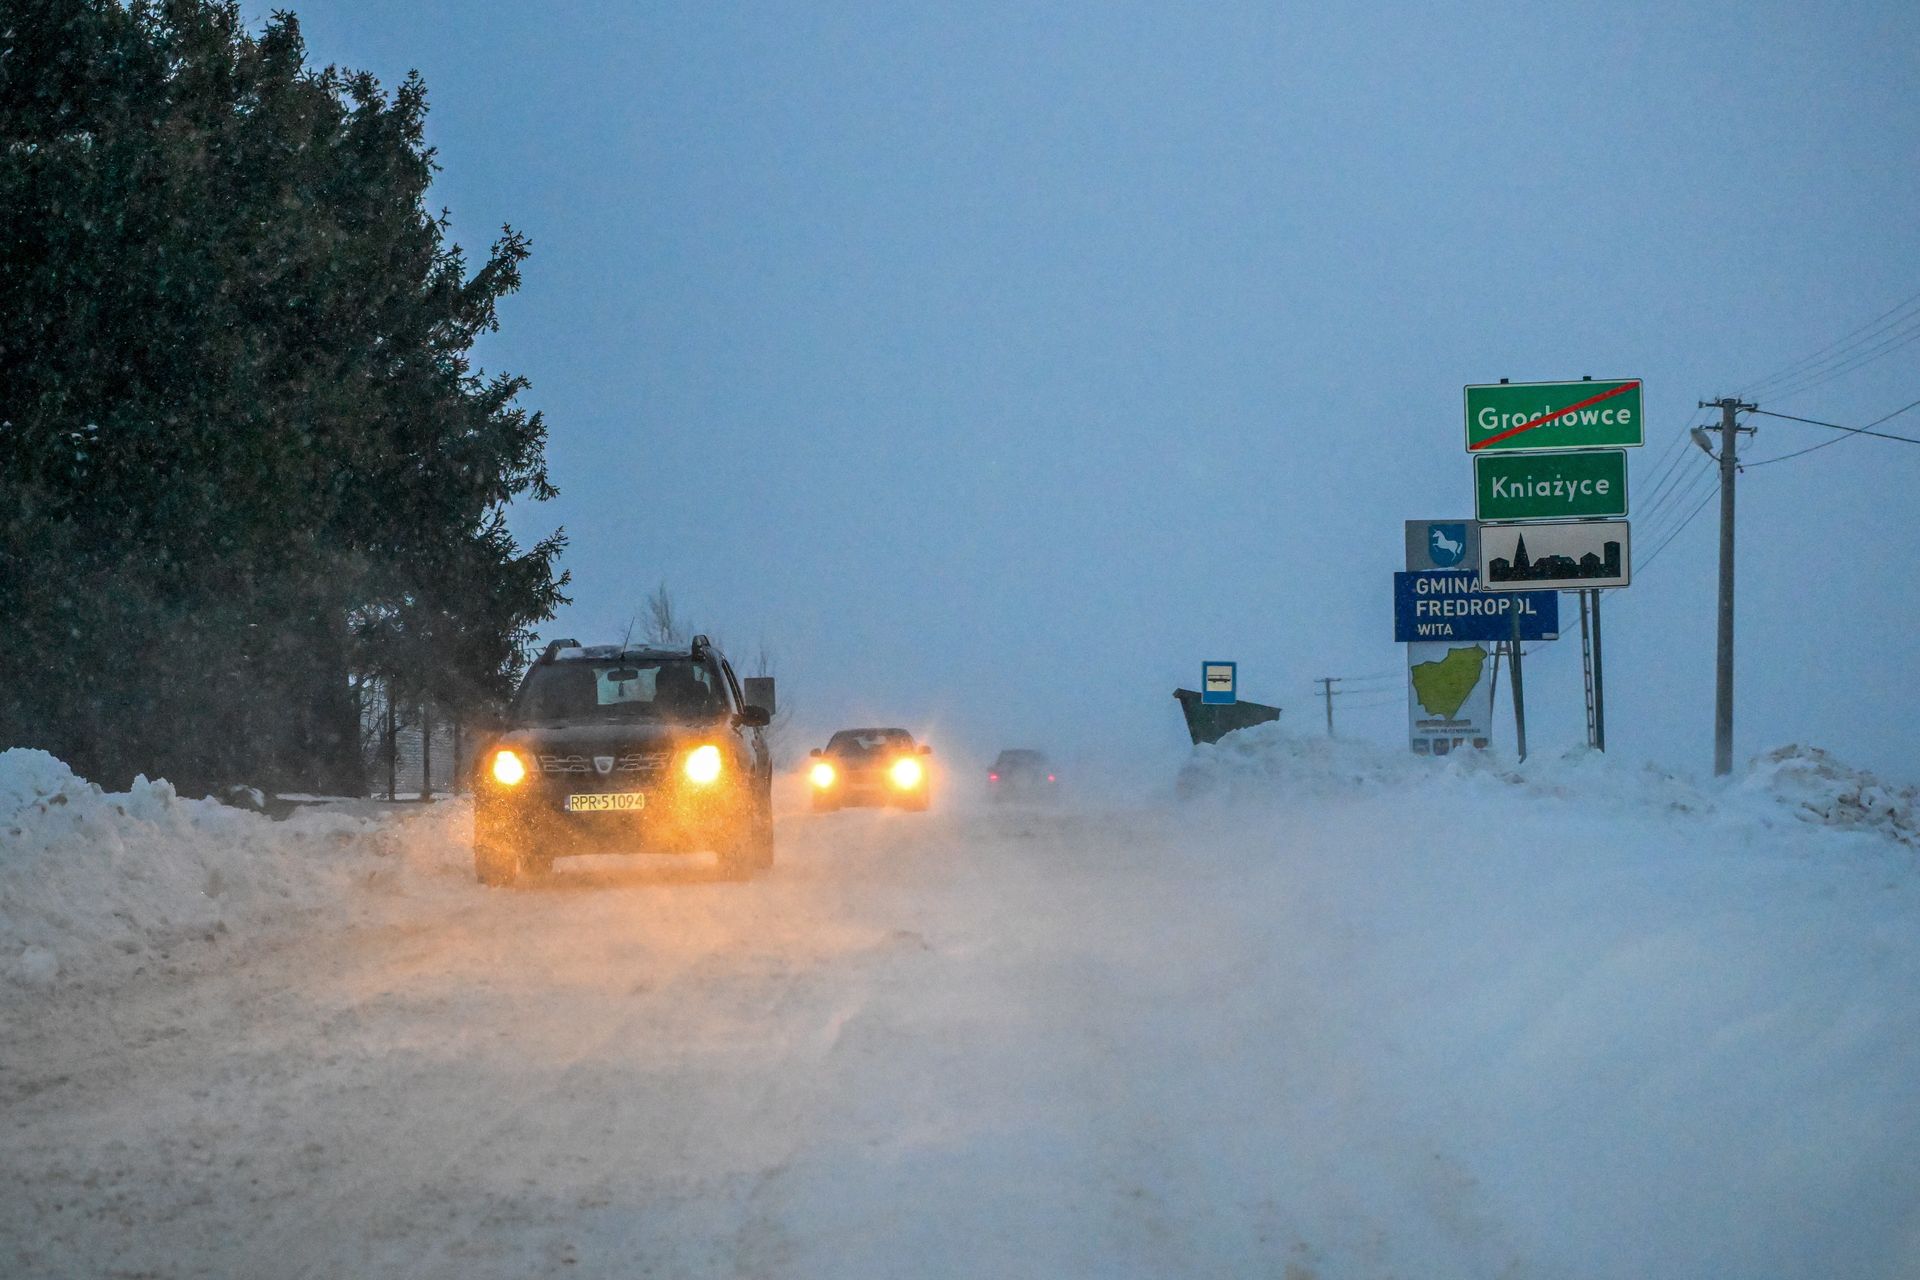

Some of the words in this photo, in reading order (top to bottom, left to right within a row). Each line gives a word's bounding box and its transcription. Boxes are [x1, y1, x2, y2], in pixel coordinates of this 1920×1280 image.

[1478, 405, 1631, 430] Grochowce
[1492, 474, 1610, 503] Kniażyce
[1416, 577, 1480, 595] GMINA
[1417, 623, 1454, 636] WITA
[571, 796, 597, 810] RPR
